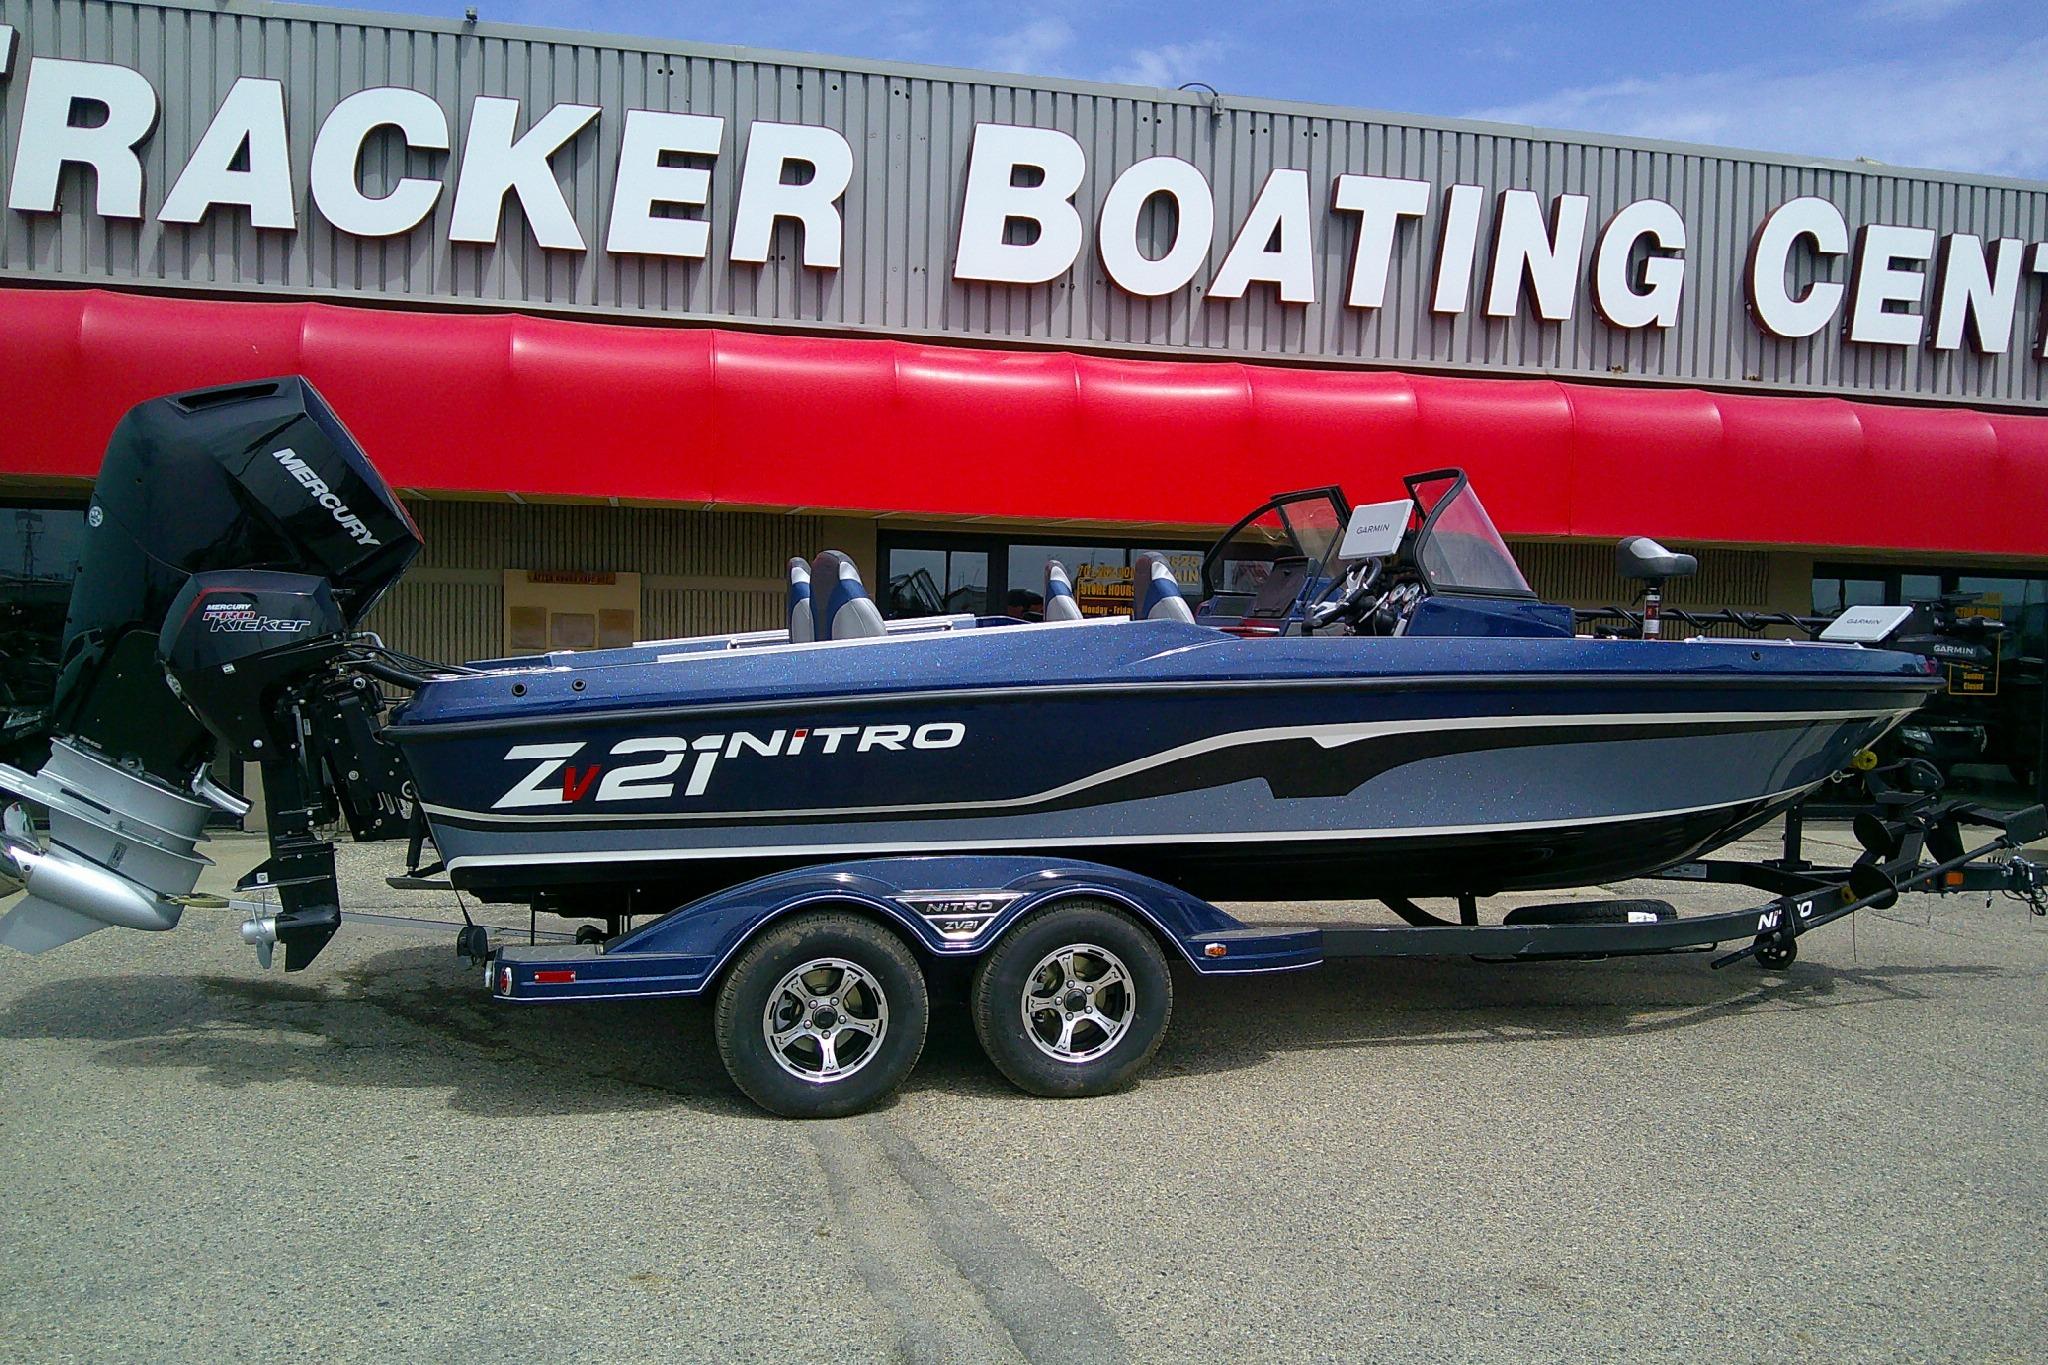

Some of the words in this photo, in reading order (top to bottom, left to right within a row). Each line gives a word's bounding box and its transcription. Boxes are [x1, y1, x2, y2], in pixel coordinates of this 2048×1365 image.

[0, 24, 854, 268] RACKER
[952, 121, 1686, 330] BOATING
[1745, 196, 2048, 358] CEN
[272, 447, 381, 547] MERCURY
[1356, 523, 1391, 535] GARMIN
[206, 603, 251, 611] MERCURY
[202, 611, 255, 620] PRO
[1846, 618, 1882, 626] GARMIN
[1934, 644, 1974, 655] GARMIN
[944, 920, 979, 930] ZV21
